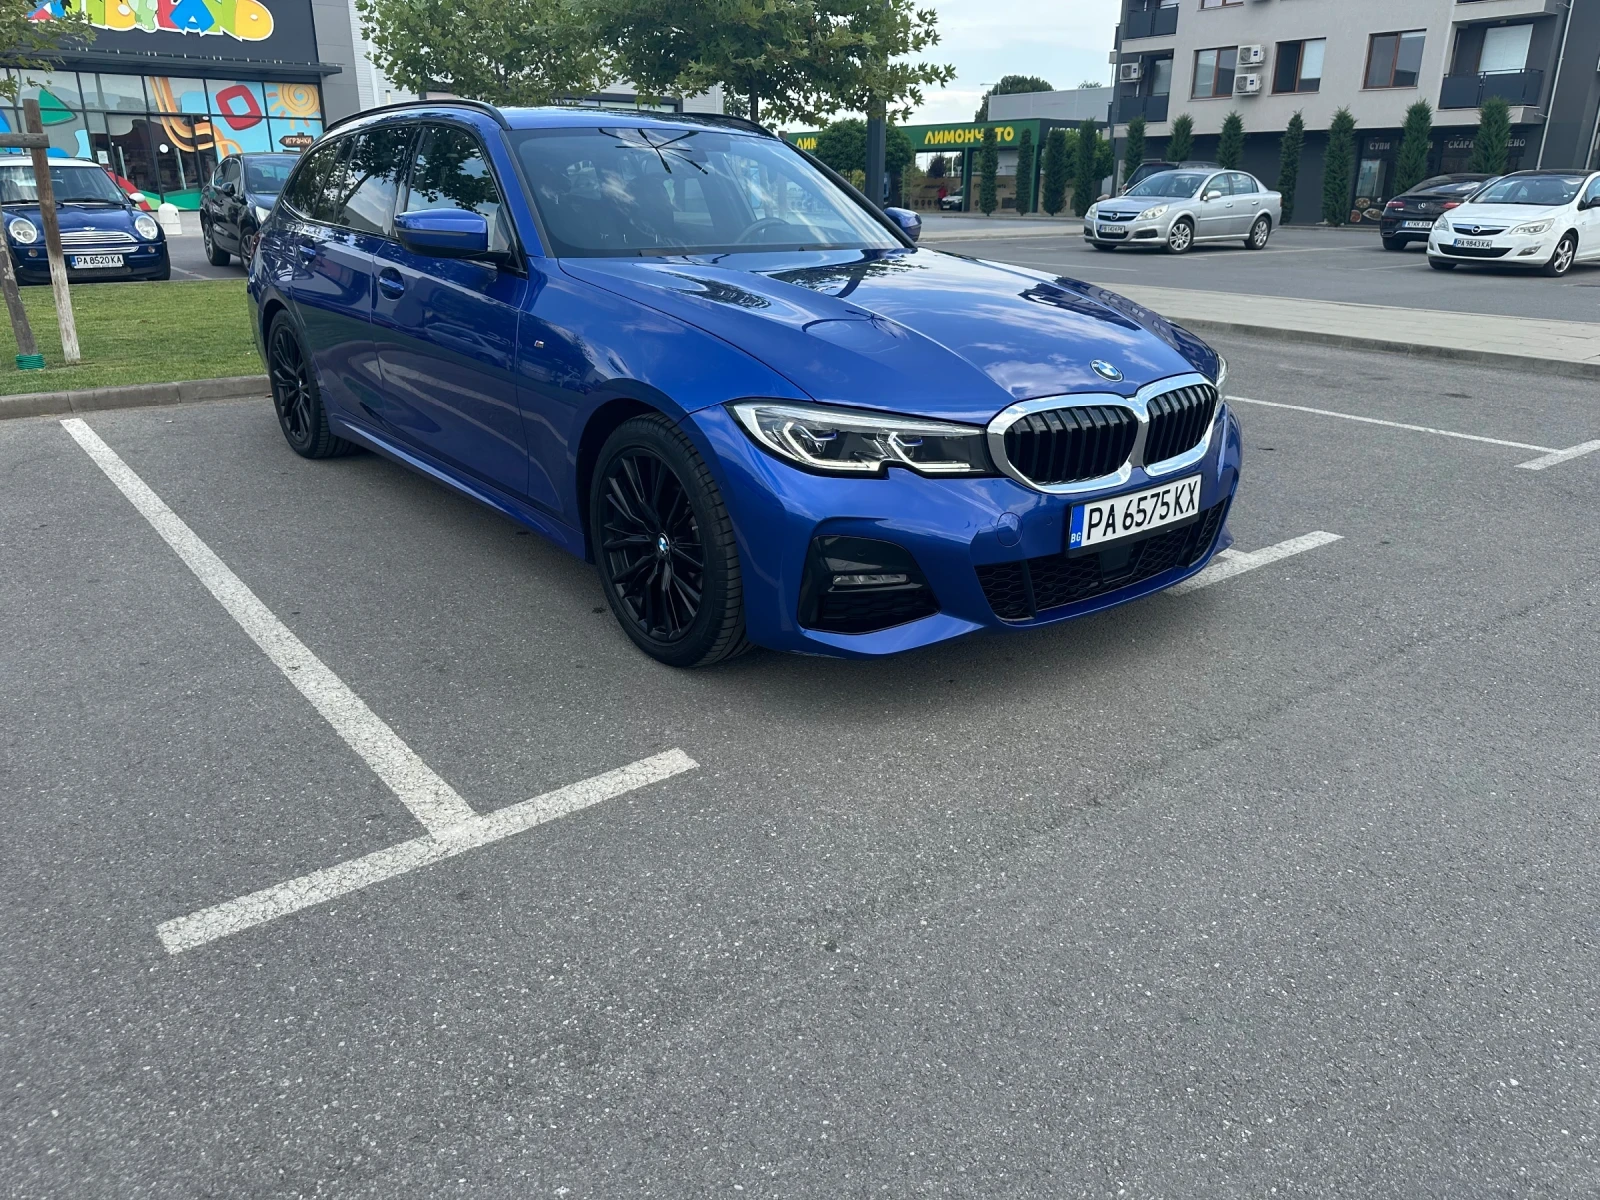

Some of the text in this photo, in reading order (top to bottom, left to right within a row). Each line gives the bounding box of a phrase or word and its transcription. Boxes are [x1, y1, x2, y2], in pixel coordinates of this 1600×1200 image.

[924, 126, 1015, 145] ЛИМОНЧТО
[76, 256, 89, 265] PA
[89, 256, 110, 264] 8520
[110, 255, 122, 264] KA
[1086, 504, 1116, 541] PA
[1070, 532, 1082, 543] BG
